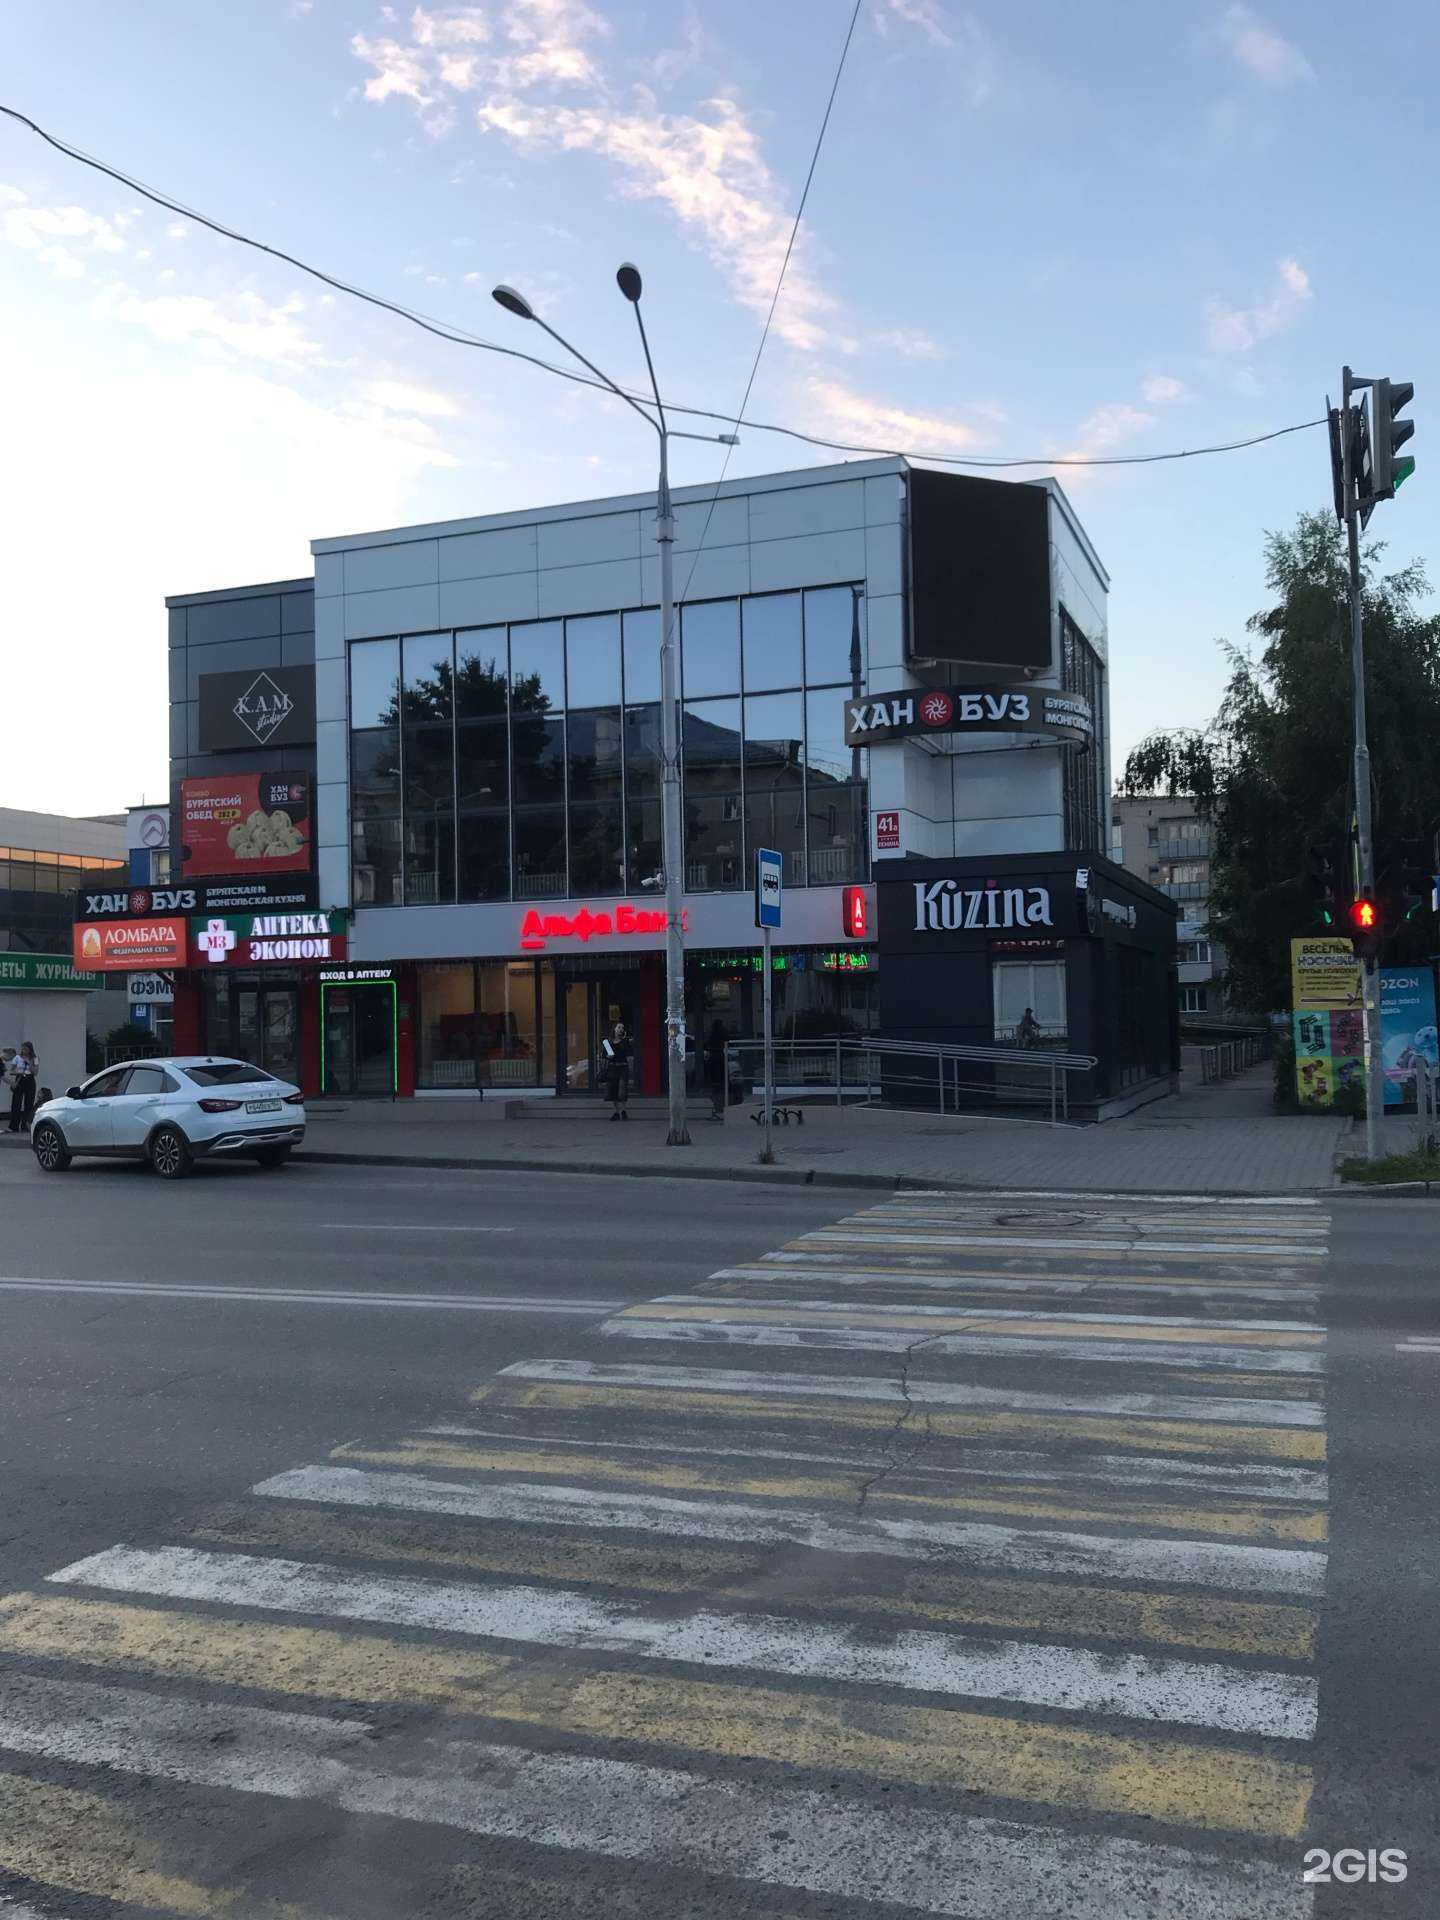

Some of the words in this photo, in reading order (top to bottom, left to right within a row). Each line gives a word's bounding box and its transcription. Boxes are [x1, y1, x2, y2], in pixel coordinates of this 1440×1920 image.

[850, 698, 914, 733] ХАН
[959, 694, 1030, 721] БУЗ
[270, 785, 288, 793] ХАН
[186, 795, 242, 809] БУРЯТСКИЙ
[270, 793, 288, 802] БУЗ
[186, 810, 213, 820] ОБЕД
[206, 887, 256, 896] БУРЯТСКАЯ
[86, 894, 128, 914] ХАН
[151, 890, 196, 911] БУЗ
[206, 897, 275, 907] МОНГОЛЬСКАЯ
[250, 914, 330, 936] АПТЕКА
[522, 908, 613, 943] Альфа
[105, 926, 176, 944] ЛОМБАРД
[250, 939, 331, 960] ЭКОНОМ
[0, 962, 26, 978] ЕТЫ
[320, 971, 346, 980] ВХОД
[347, 971, 354, 979] В
[356, 969, 392, 978] АПТЕКУ
[131, 981, 174, 995] ФЭМ
